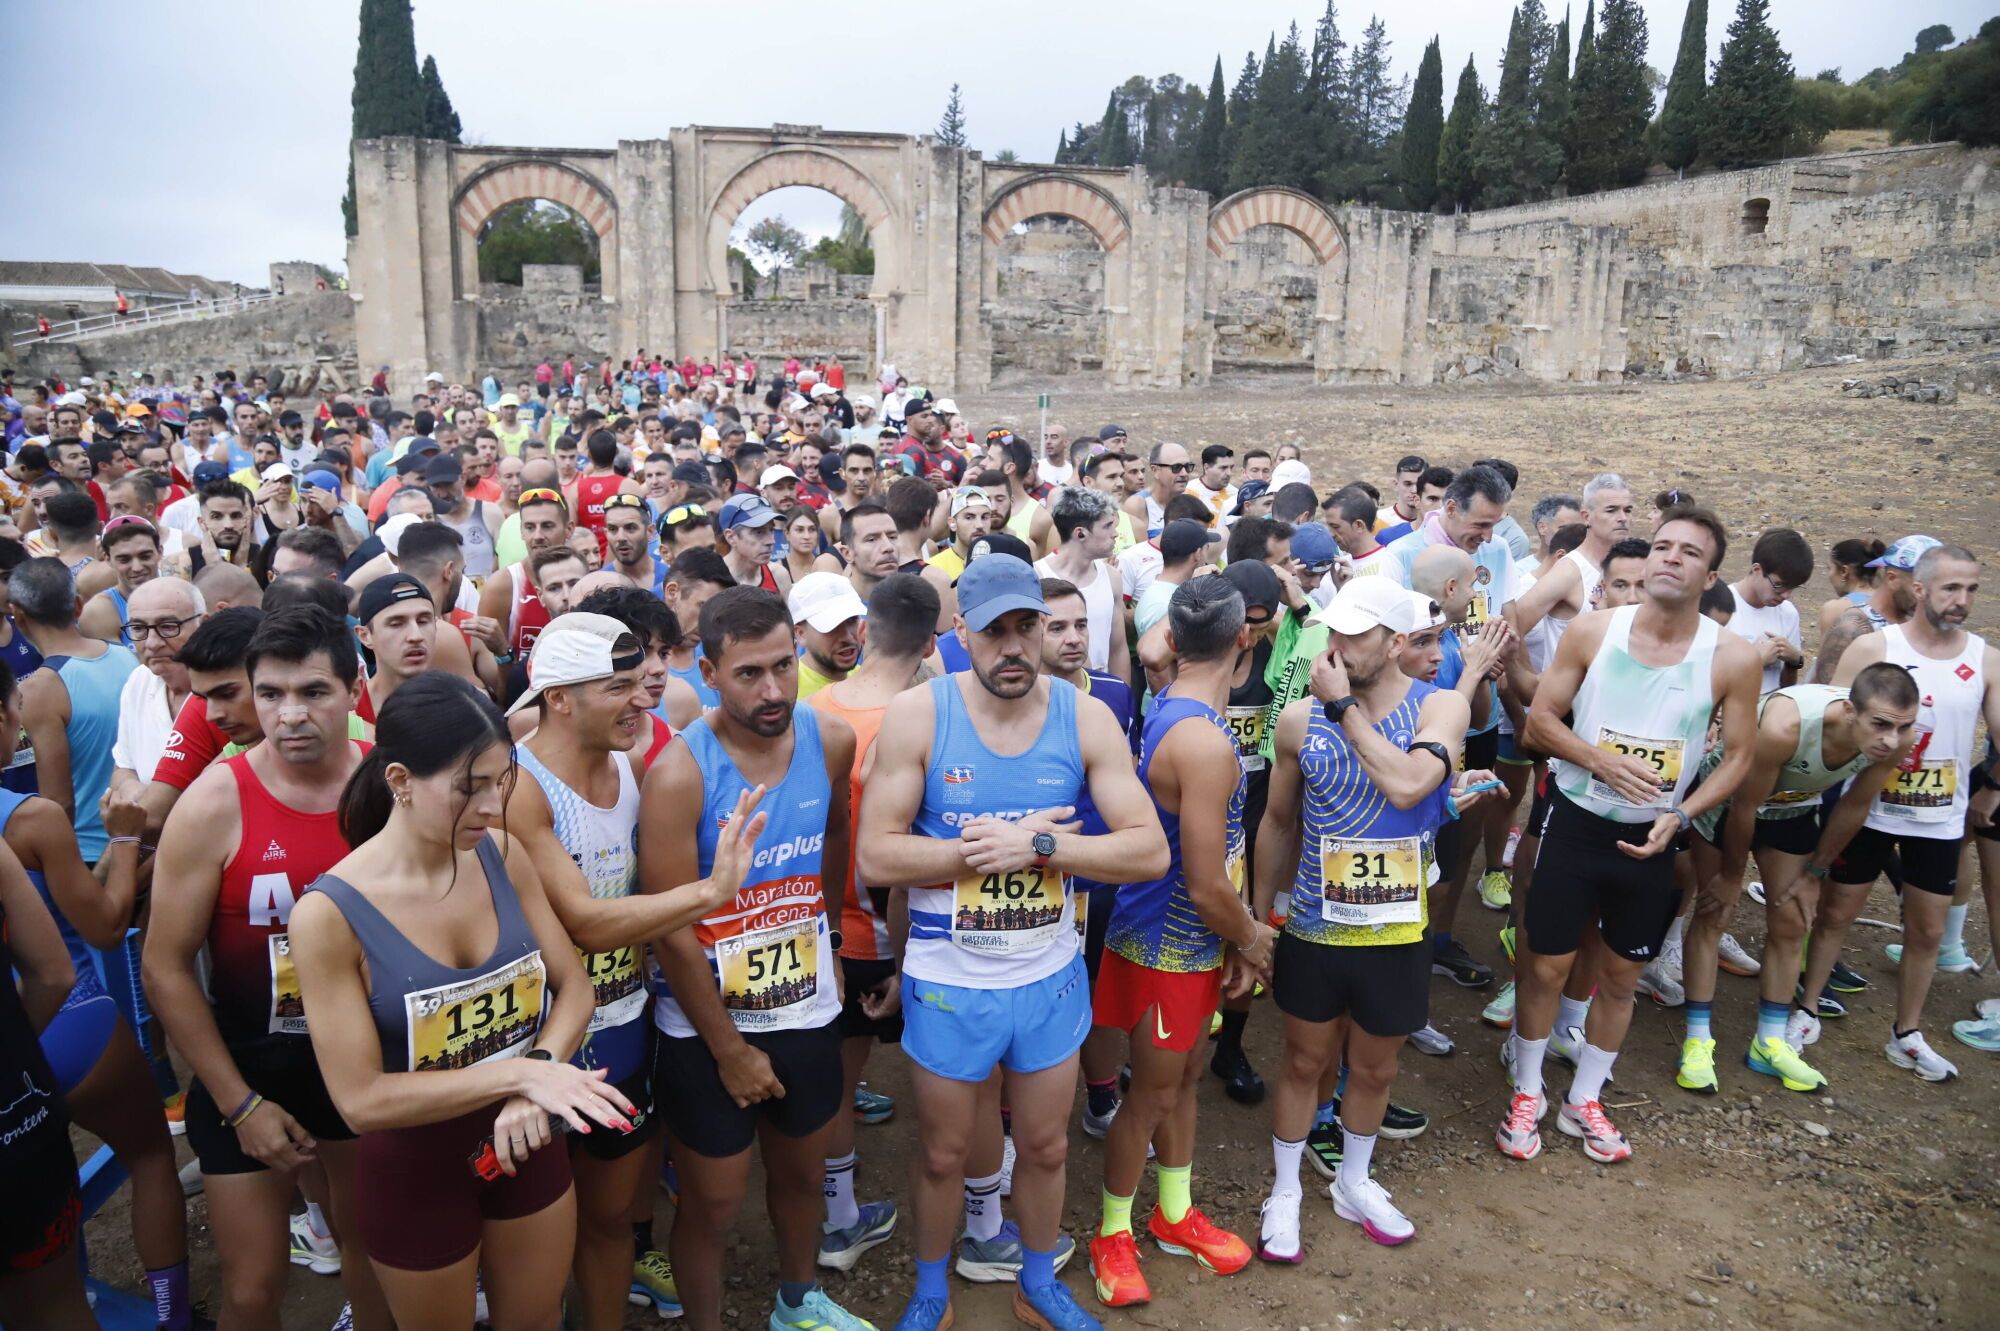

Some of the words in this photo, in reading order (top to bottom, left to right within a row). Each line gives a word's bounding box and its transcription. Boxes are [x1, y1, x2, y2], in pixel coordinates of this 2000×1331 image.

[1230, 717, 1256, 736] 56
[1897, 769, 1944, 788] 471
[263, 849, 287, 858] AIRE
[594, 845, 621, 860] DOWN
[753, 832, 824, 868] erplus
[1326, 842, 1341, 853] 39
[1352, 853, 1390, 878] 31
[735, 877, 815, 911] Maratón
[980, 868, 1045, 900] 462
[743, 905, 810, 933] Lucena
[277, 940, 290, 956] 3
[962, 934, 1002, 942] carreras
[962, 939, 1009, 947] populares
[722, 942, 742, 957] 39
[747, 939, 801, 982] 571
[415, 996, 442, 1018] 39
[446, 983, 519, 1041] 131
[0, 1105, 49, 1145] ontera
[153, 1278, 171, 1321] MOYANO
